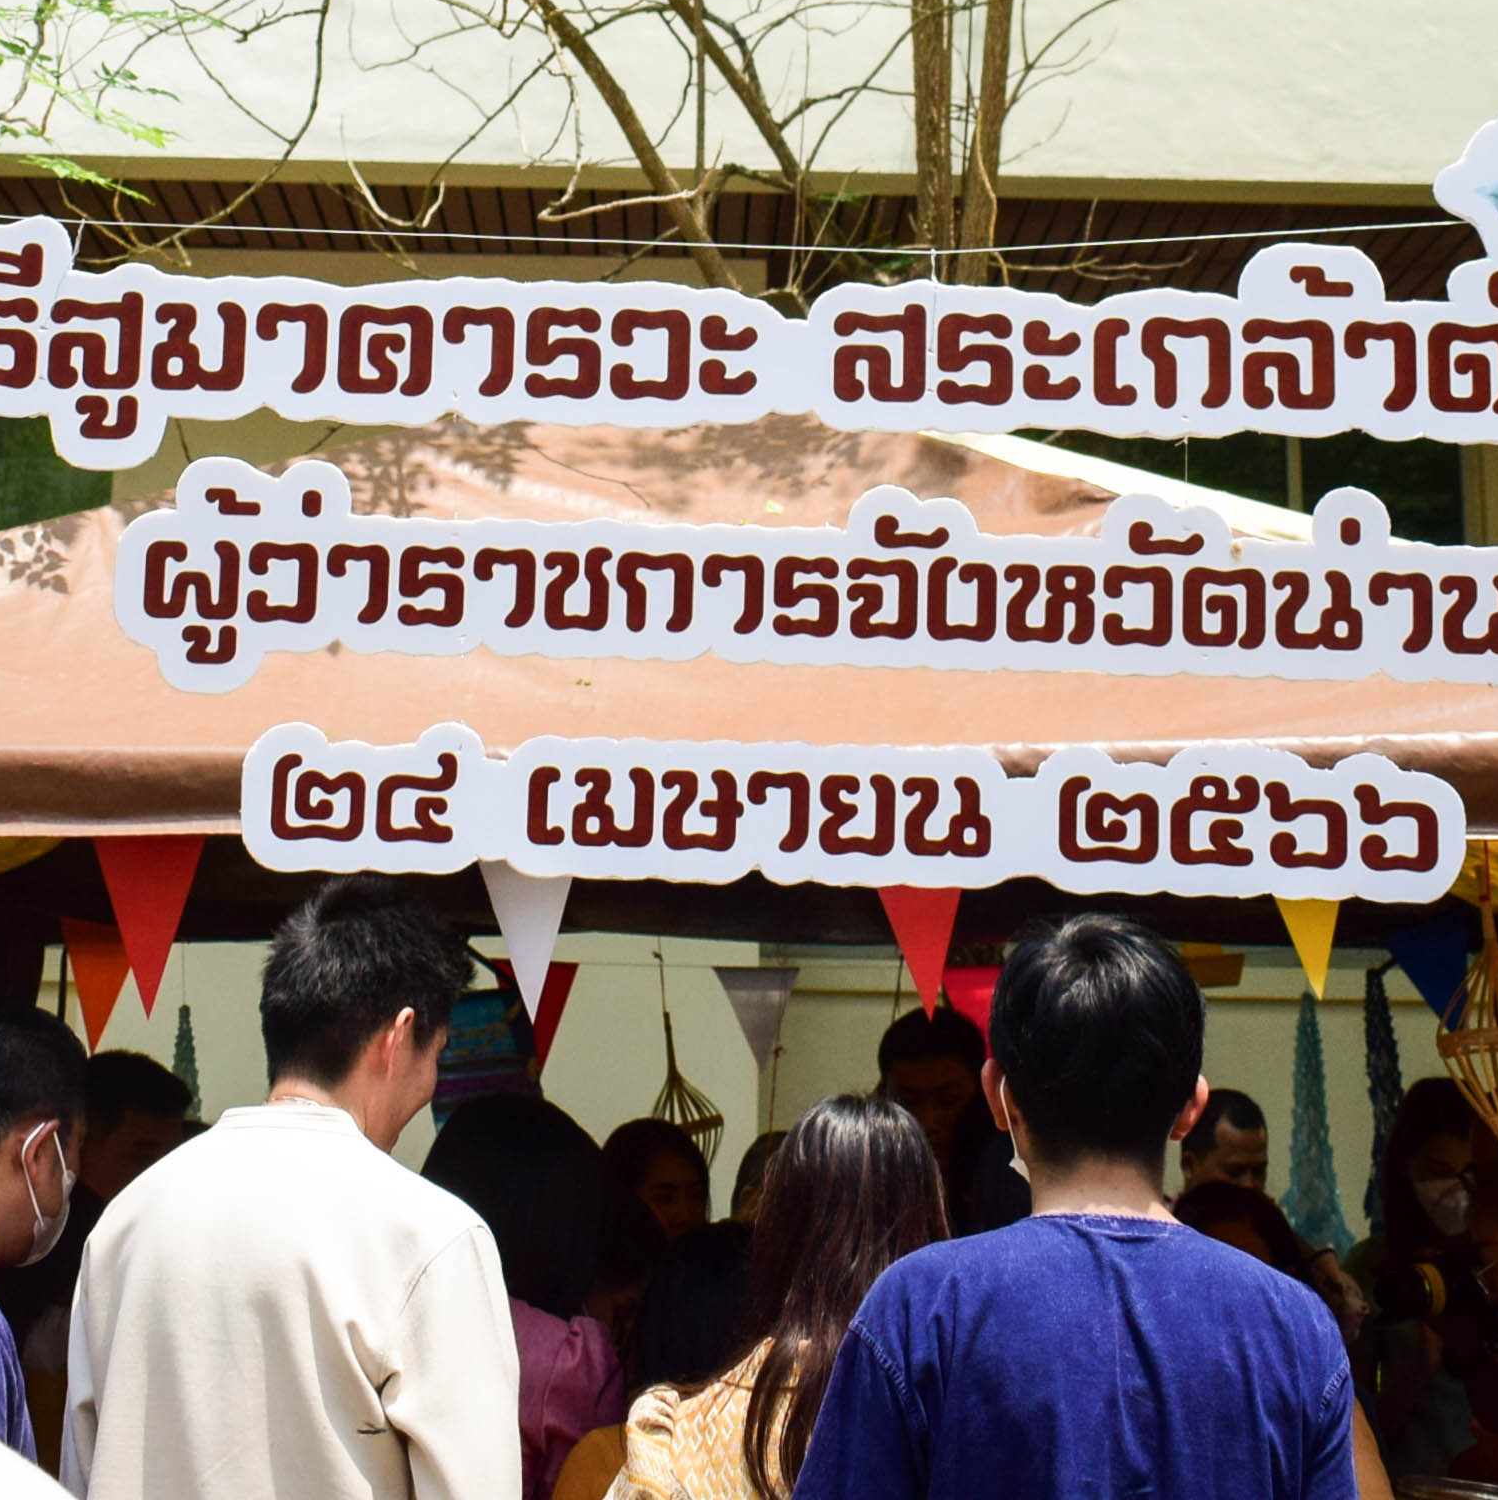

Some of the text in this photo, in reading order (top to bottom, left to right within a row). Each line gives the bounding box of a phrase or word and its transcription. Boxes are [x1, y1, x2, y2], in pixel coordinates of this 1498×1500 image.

[270, 752, 1438, 872] ๒๔ เมษายน ๒๕๖๖
